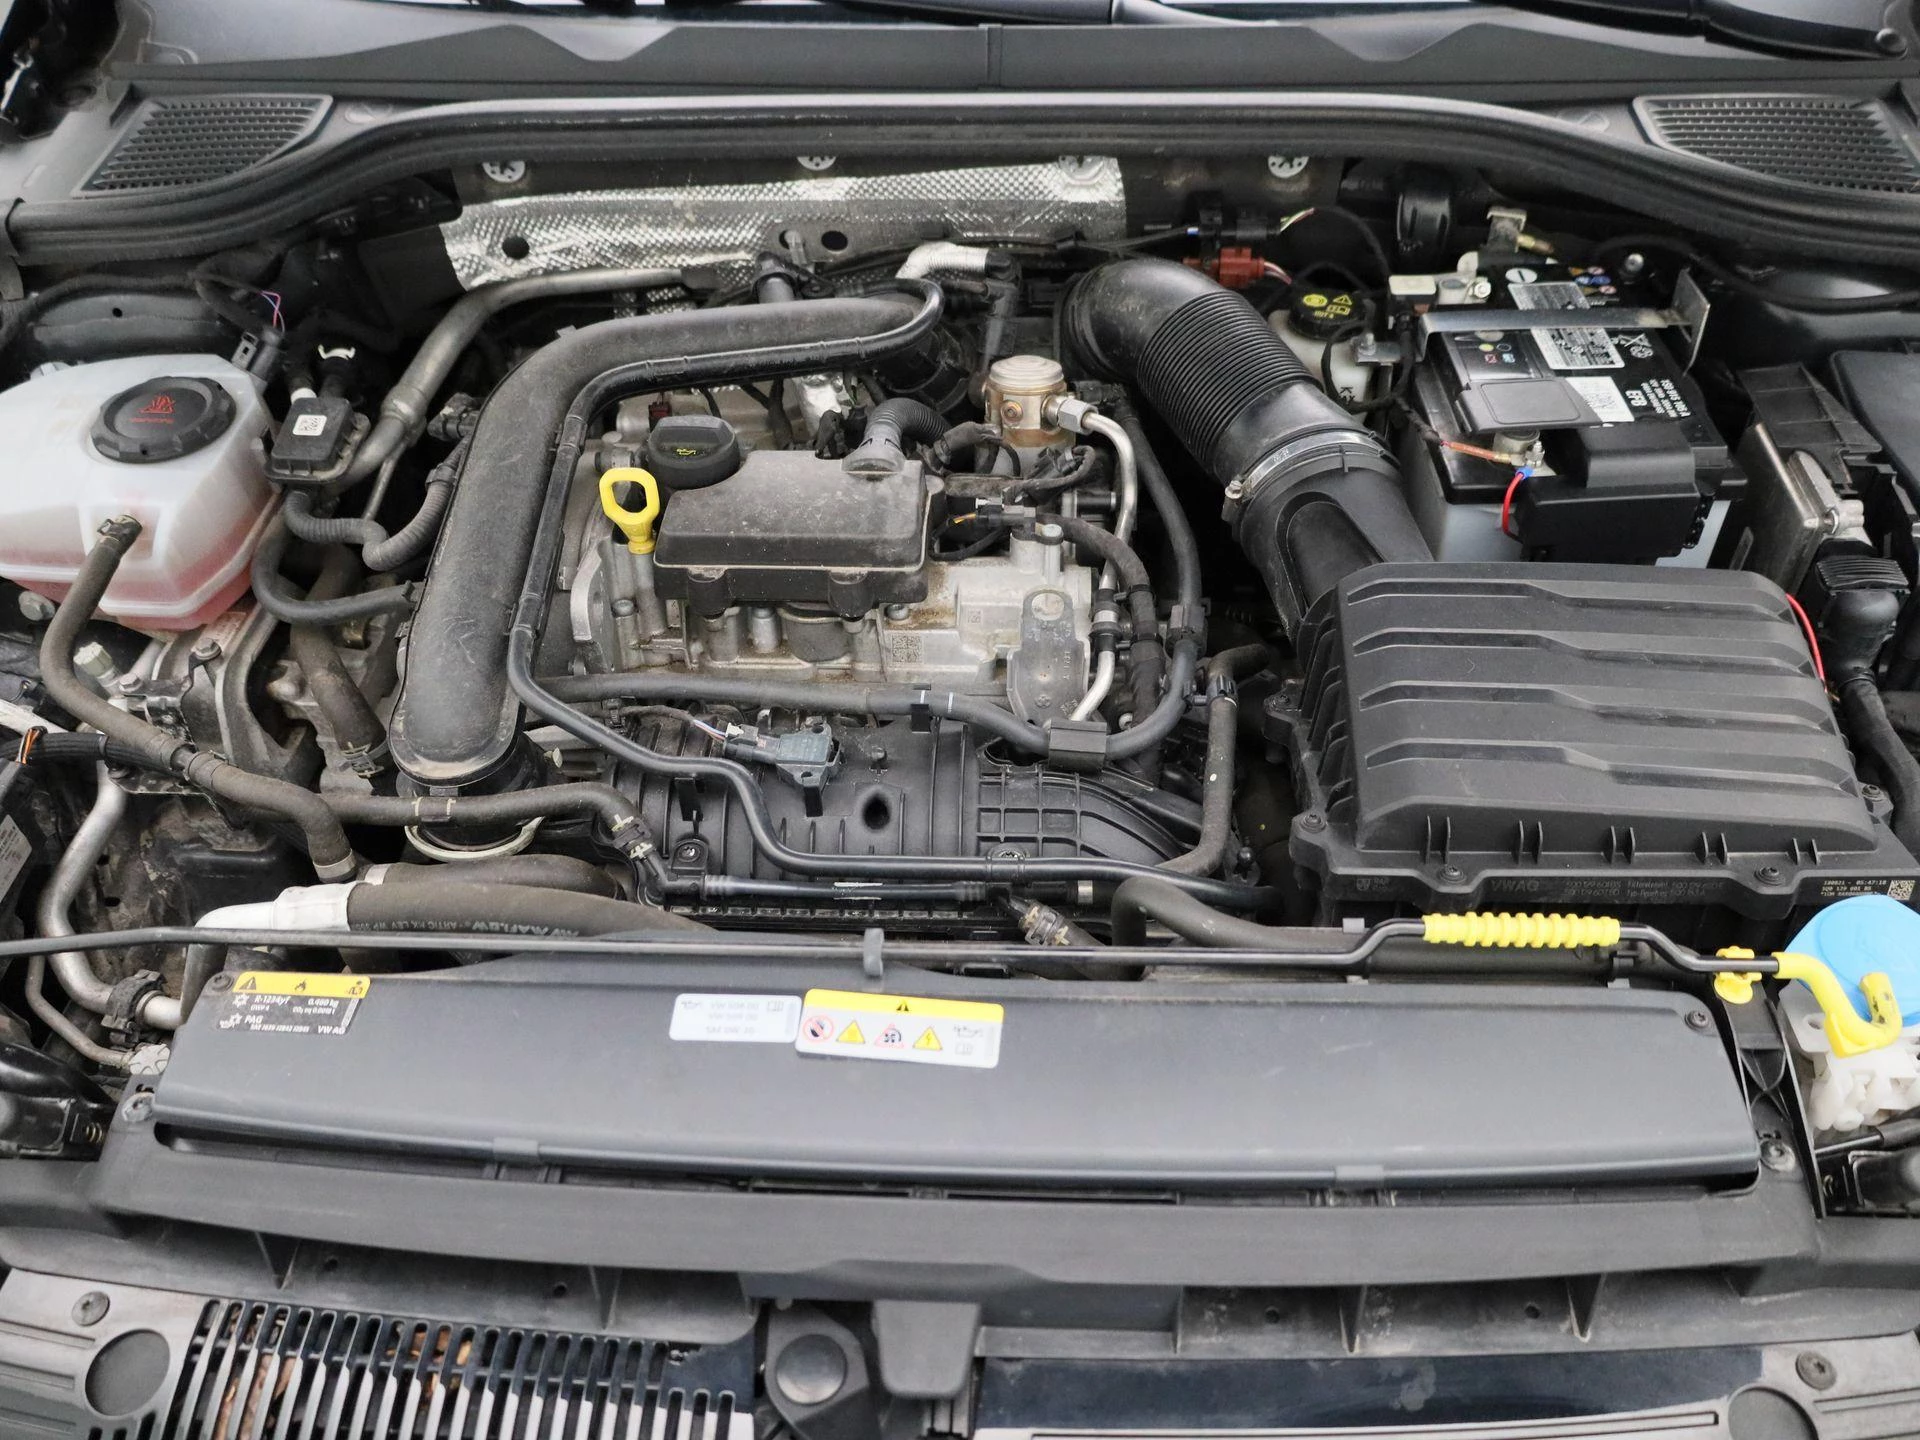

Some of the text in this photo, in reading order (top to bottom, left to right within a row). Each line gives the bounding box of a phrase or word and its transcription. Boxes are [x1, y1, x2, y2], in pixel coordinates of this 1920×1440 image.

[1625, 390, 1648, 406] EFB
[254, 995, 291, 1005] R-1234yf
[244, 1015, 264, 1024] PAG
[318, 1025, 332, 1034] VW
[332, 1025, 346, 1035] AG
